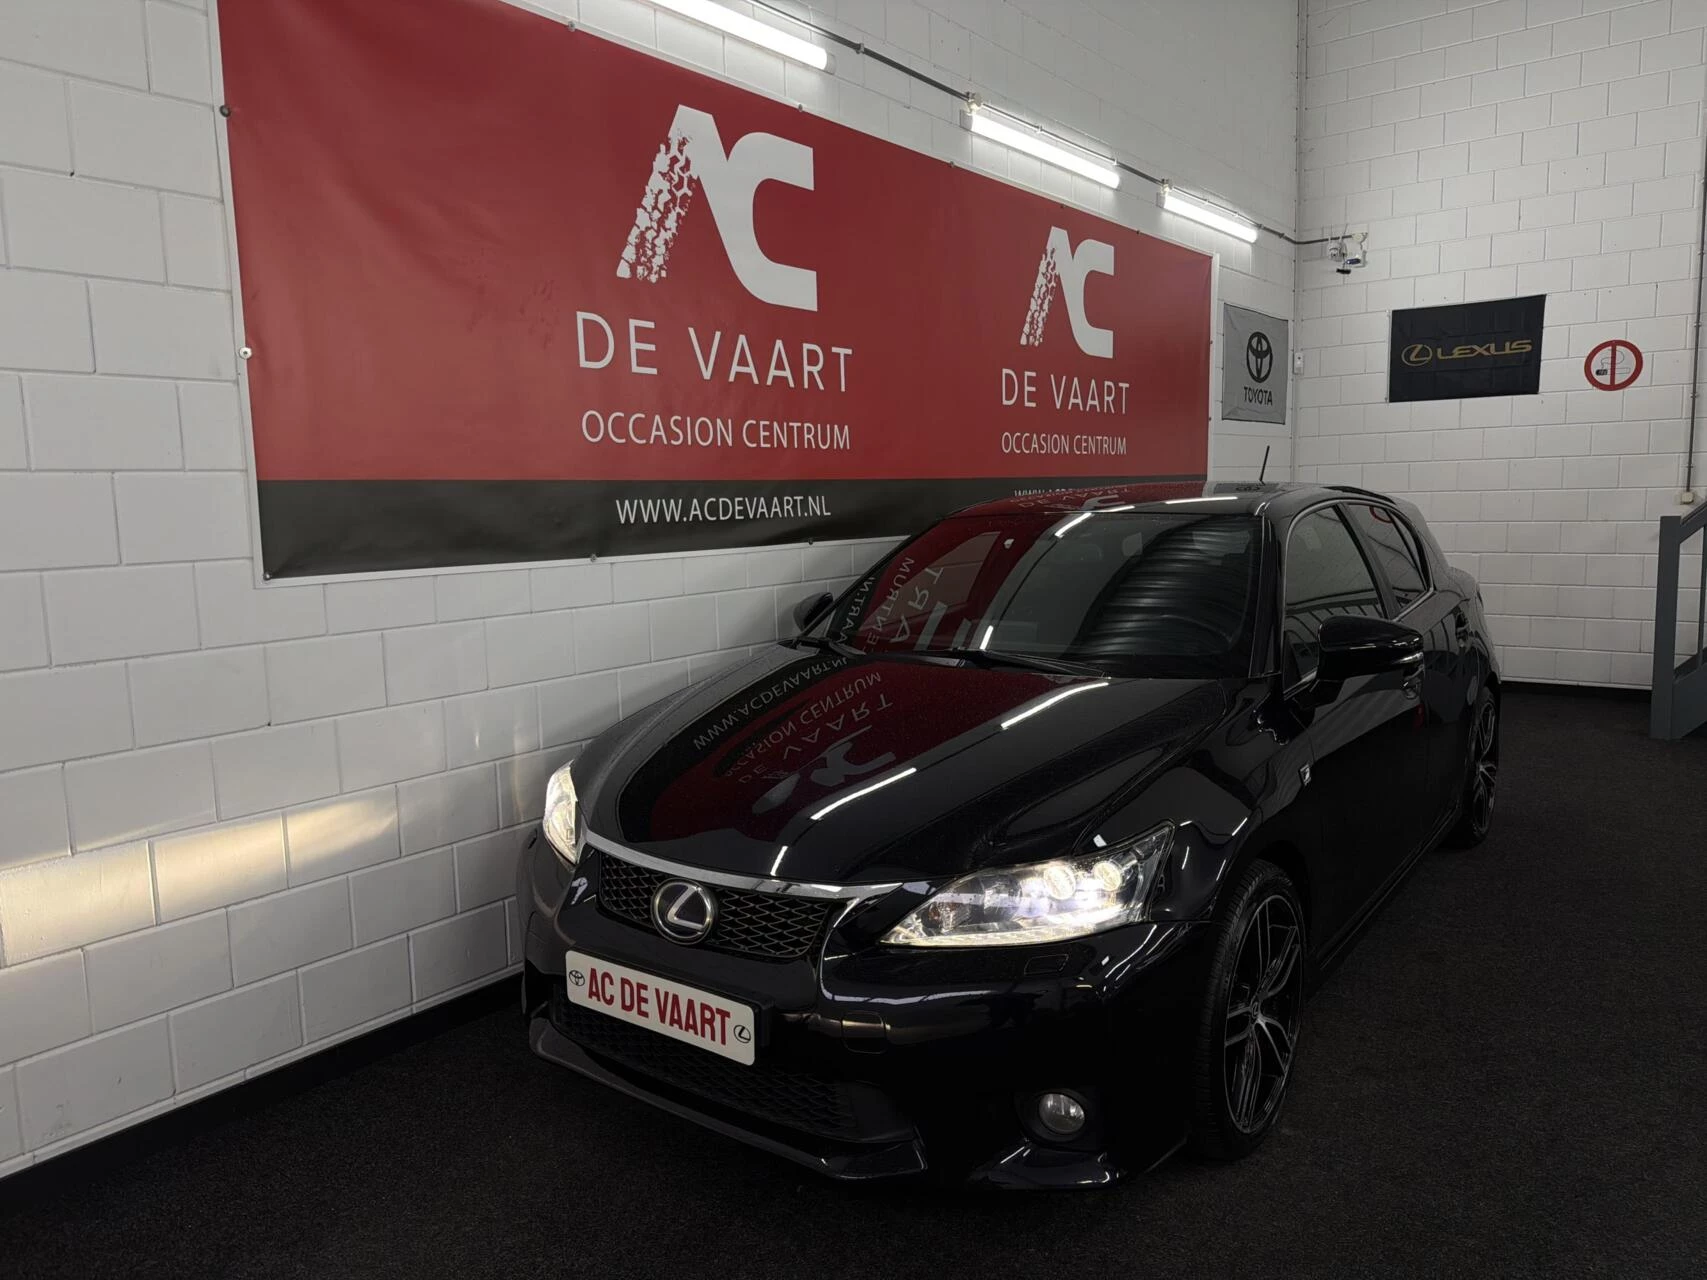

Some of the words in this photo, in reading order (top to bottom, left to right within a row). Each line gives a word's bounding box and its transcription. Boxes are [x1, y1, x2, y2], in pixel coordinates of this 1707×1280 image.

[616, 104, 817, 312] AC
[1020, 226, 1114, 358] AC
[576, 311, 658, 375] DE
[688, 327, 853, 392] VAART
[1437, 339, 1533, 360] LEXUS
[1001, 368, 1037, 408] DE
[1050, 374, 1130, 415] VAART
[1243, 386, 1273, 406] TOYOTA
[581, 410, 733, 447] OCCASION
[742, 419, 850, 450] CENTRUM
[1001, 431, 1070, 454] OCCASION
[1073, 434, 1127, 455] CENTRUM
[615, 495, 831, 524] WWW.ACDEVAART.NL
[588, 967, 614, 1006] AC
[620, 976, 649, 1018] DE
[655, 987, 731, 1046] VAART
